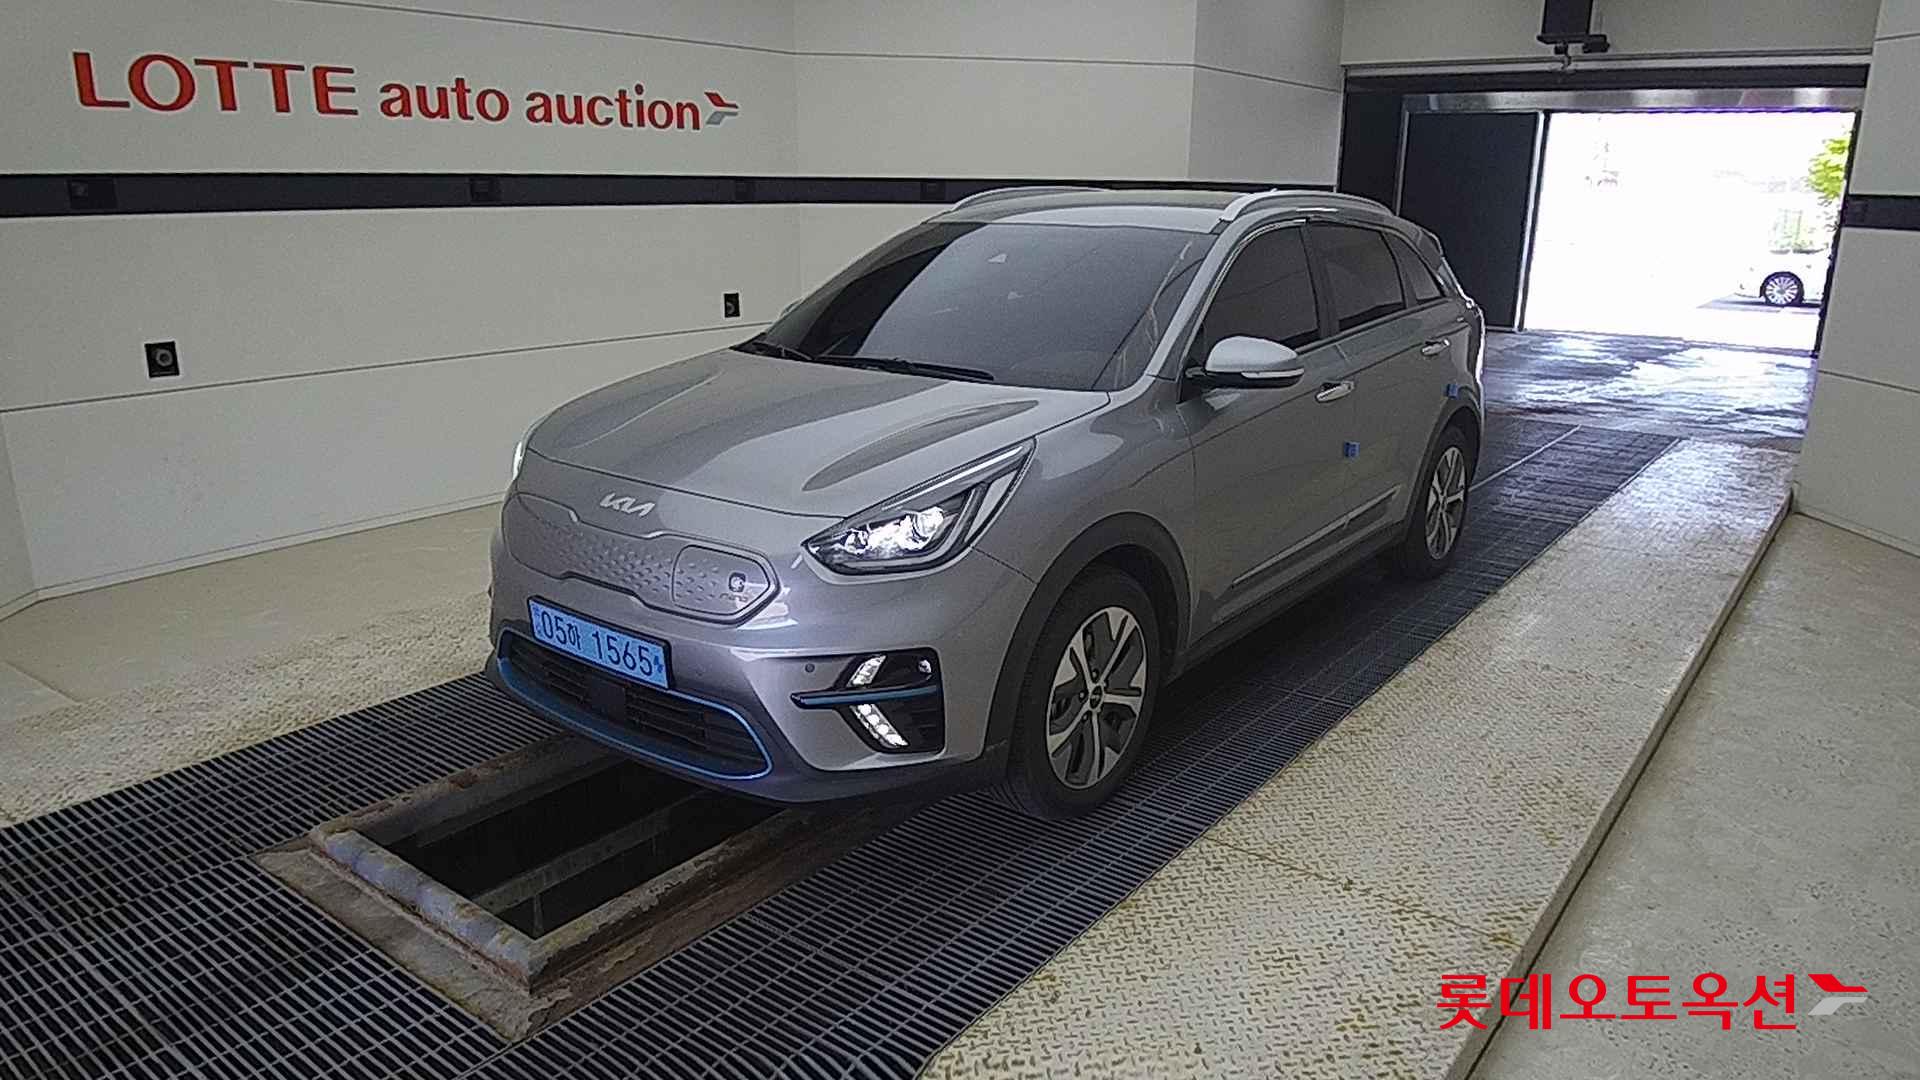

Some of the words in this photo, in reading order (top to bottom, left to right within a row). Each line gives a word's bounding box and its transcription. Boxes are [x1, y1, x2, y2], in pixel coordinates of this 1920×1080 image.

[73, 51, 359, 117] LOTTE
[380, 77, 509, 122] auto
[525, 84, 700, 130] auction
[592, 629, 654, 677] 1565
